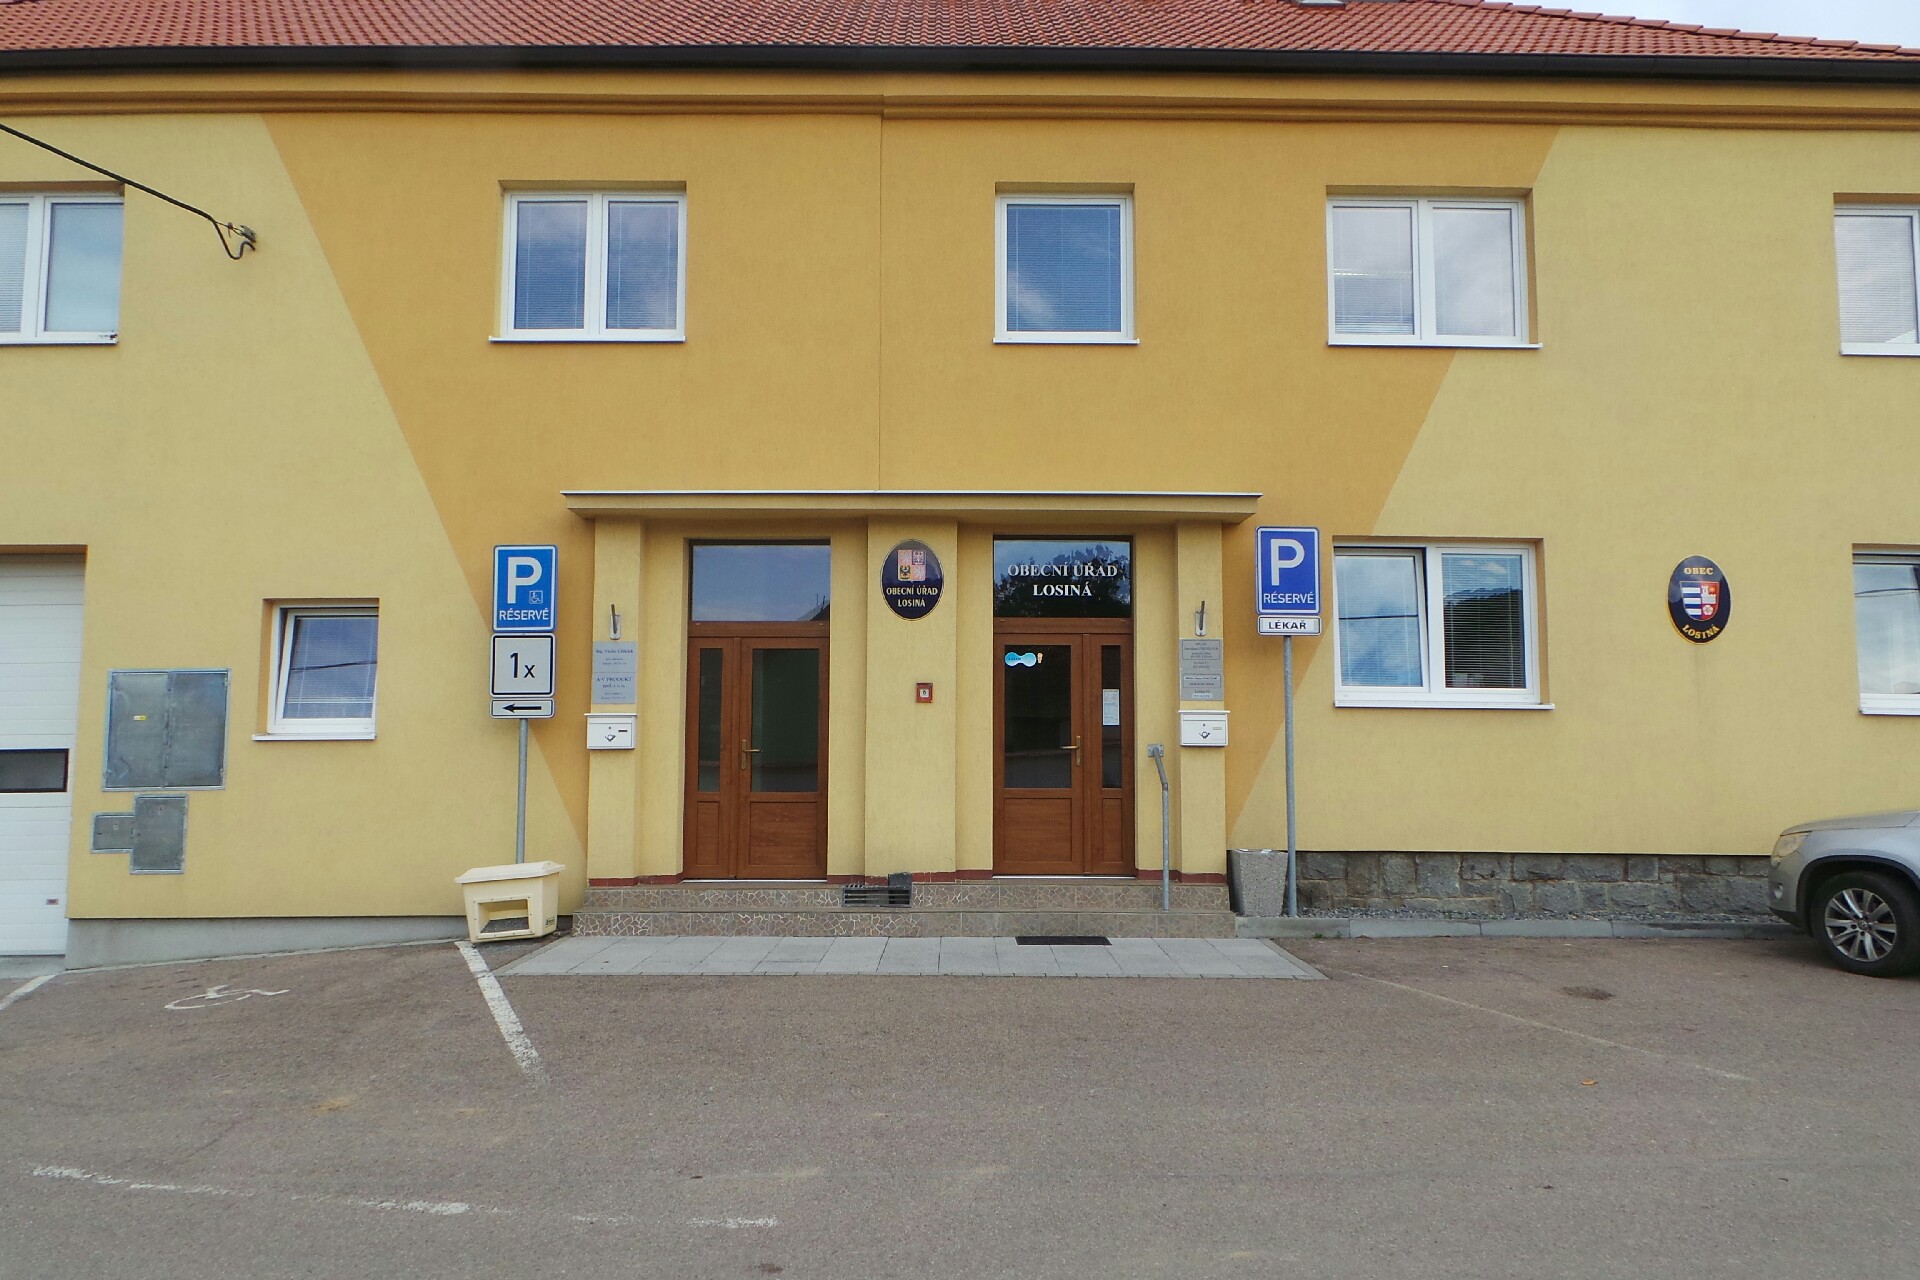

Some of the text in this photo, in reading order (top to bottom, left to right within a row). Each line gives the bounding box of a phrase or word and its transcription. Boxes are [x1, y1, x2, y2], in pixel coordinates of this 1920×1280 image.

[1007, 561, 1118, 577] OBECNÍ ÚŘAD
[1270, 538, 1305, 586] P
[1683, 567, 1714, 575] OBEC
[507, 556, 543, 604] P
[886, 584, 939, 596] OBECNÍ ÚŘAD
[1032, 581, 1093, 597] LOSINÁ
[897, 598, 926, 608] LOSINÁ
[1263, 590, 1315, 604] RÉSERVÉ
[499, 608, 550, 621] RÉSERVÉ
[1268, 619, 1307, 630] LÉKAŘ
[1682, 624, 1721, 639] LOSINÁ
